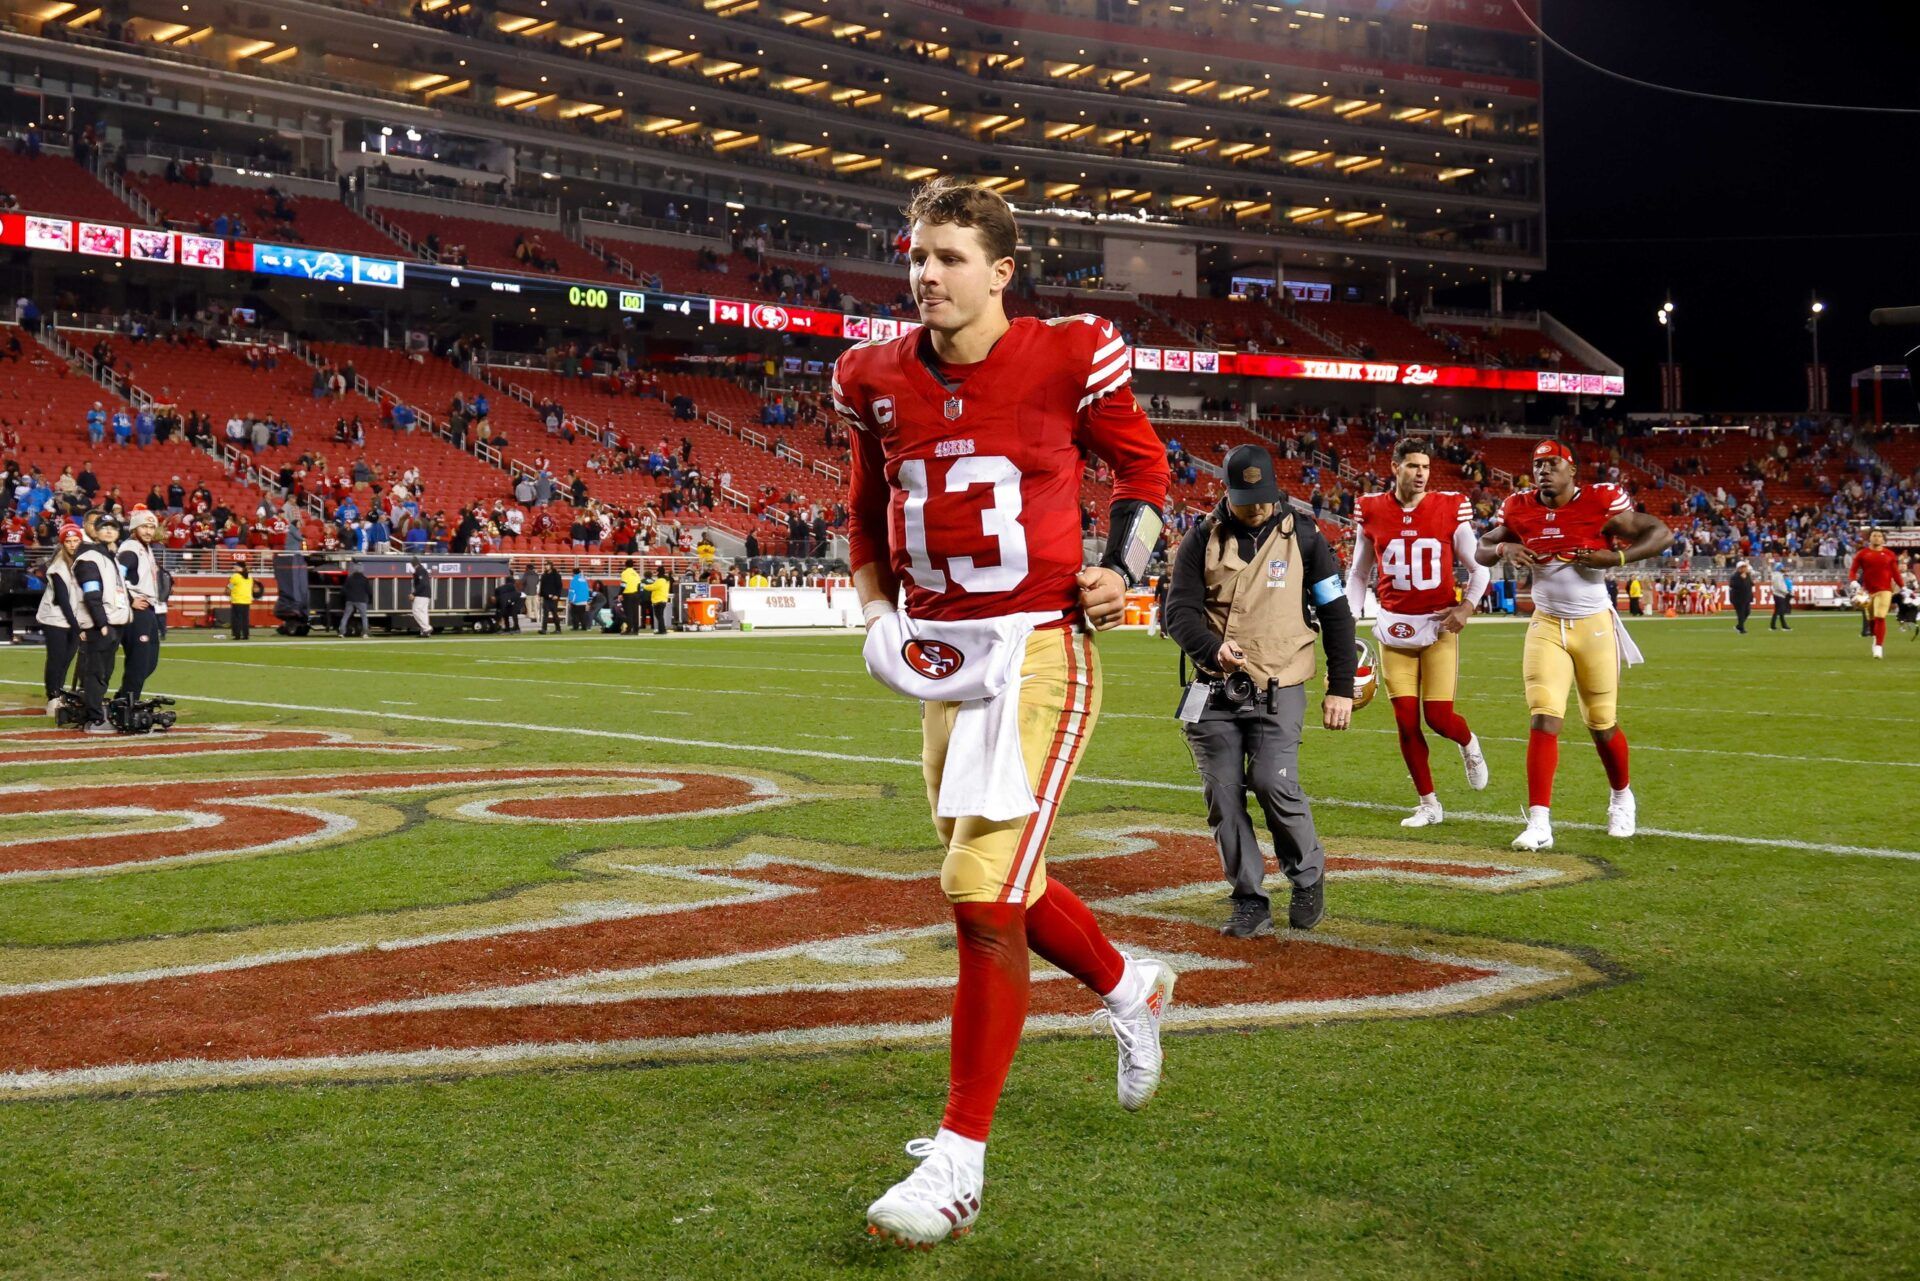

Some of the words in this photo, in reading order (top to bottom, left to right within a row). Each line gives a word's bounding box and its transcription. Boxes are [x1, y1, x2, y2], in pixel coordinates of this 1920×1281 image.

[366, 264, 392, 281] 40
[569, 286, 608, 308] 0:00
[624, 296, 640, 309] 00
[680, 300, 690, 315] 4
[720, 305, 738, 321] 34
[1303, 361, 1363, 379] THANK
[1365, 364, 1399, 382] YOU
[872, 398, 893, 425] C
[934, 438, 976, 457] 49ERS
[897, 456, 1030, 594] 13
[1381, 537, 1442, 591] 40
[765, 596, 796, 608] 49ERS
